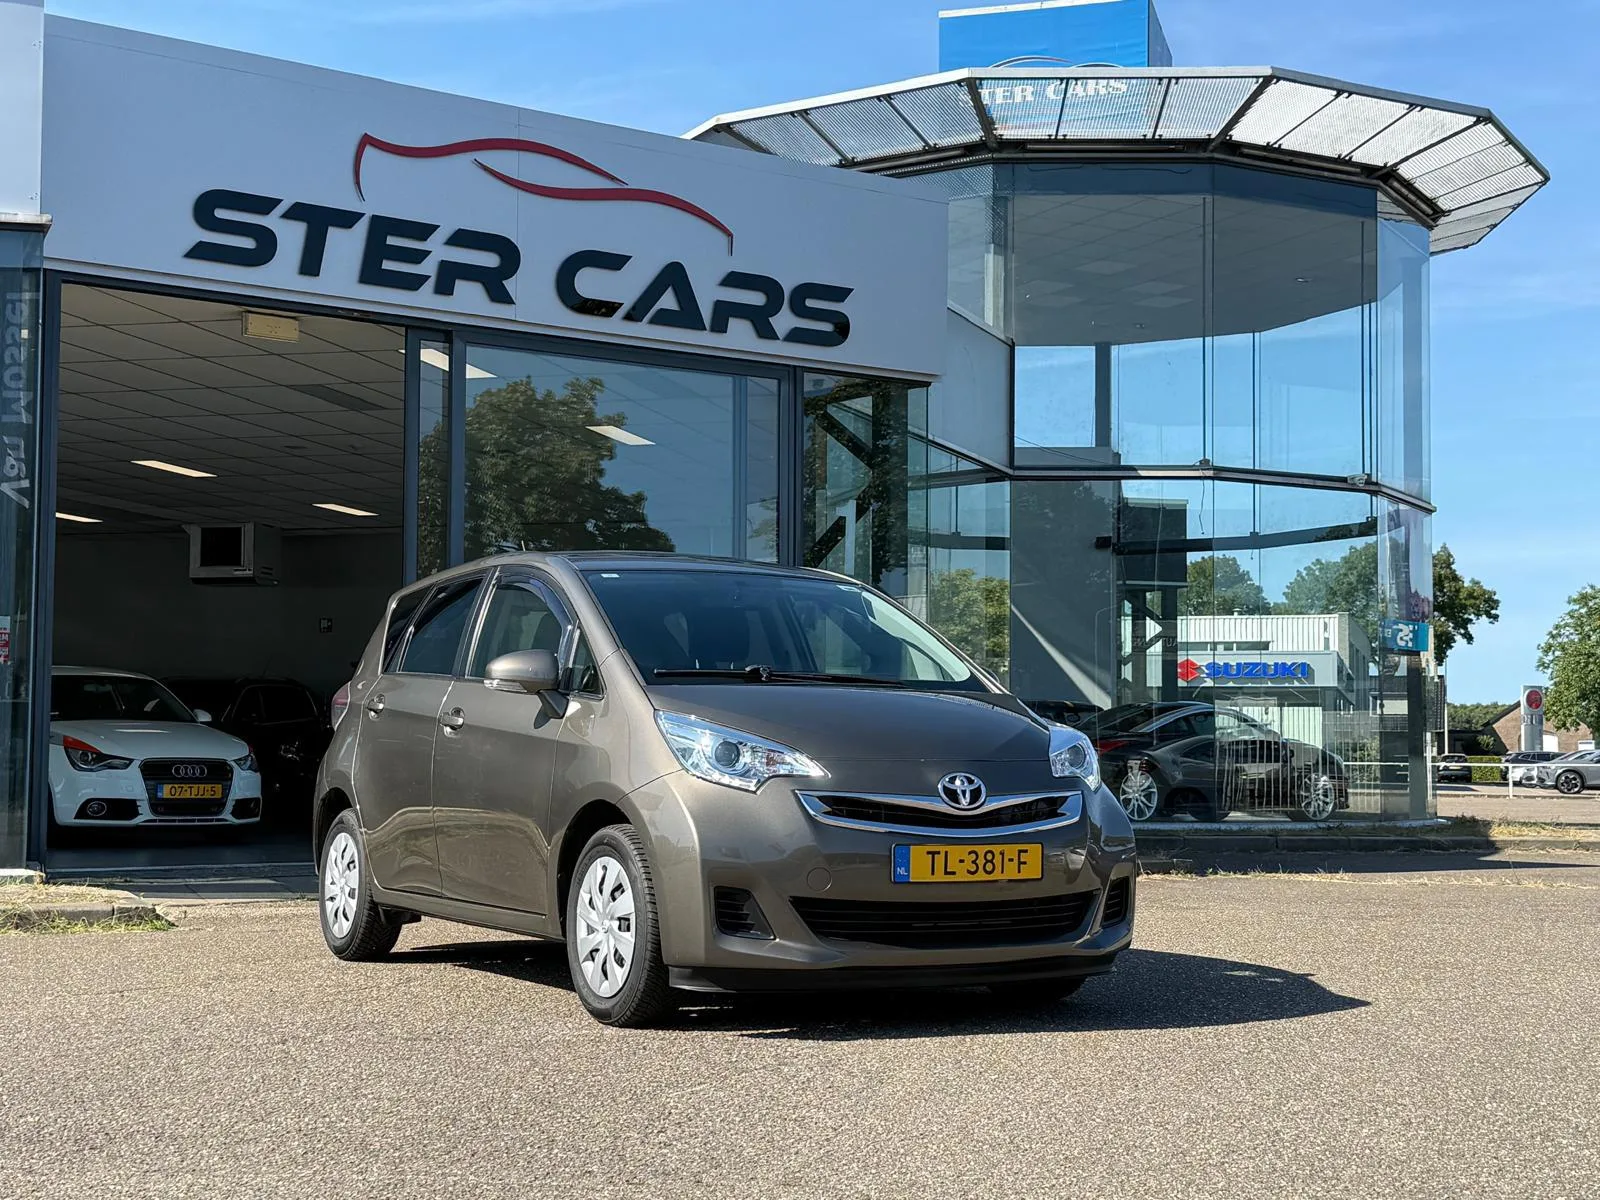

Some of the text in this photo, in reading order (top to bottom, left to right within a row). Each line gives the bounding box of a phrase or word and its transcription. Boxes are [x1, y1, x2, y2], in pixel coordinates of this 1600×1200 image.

[183, 189, 855, 347] STER CARS
[1203, 661, 1309, 679] SUZUKI
[169, 785, 216, 797] 07-TJJ-5
[896, 866, 908, 876] NL
[926, 849, 1028, 876] TL-381-F
